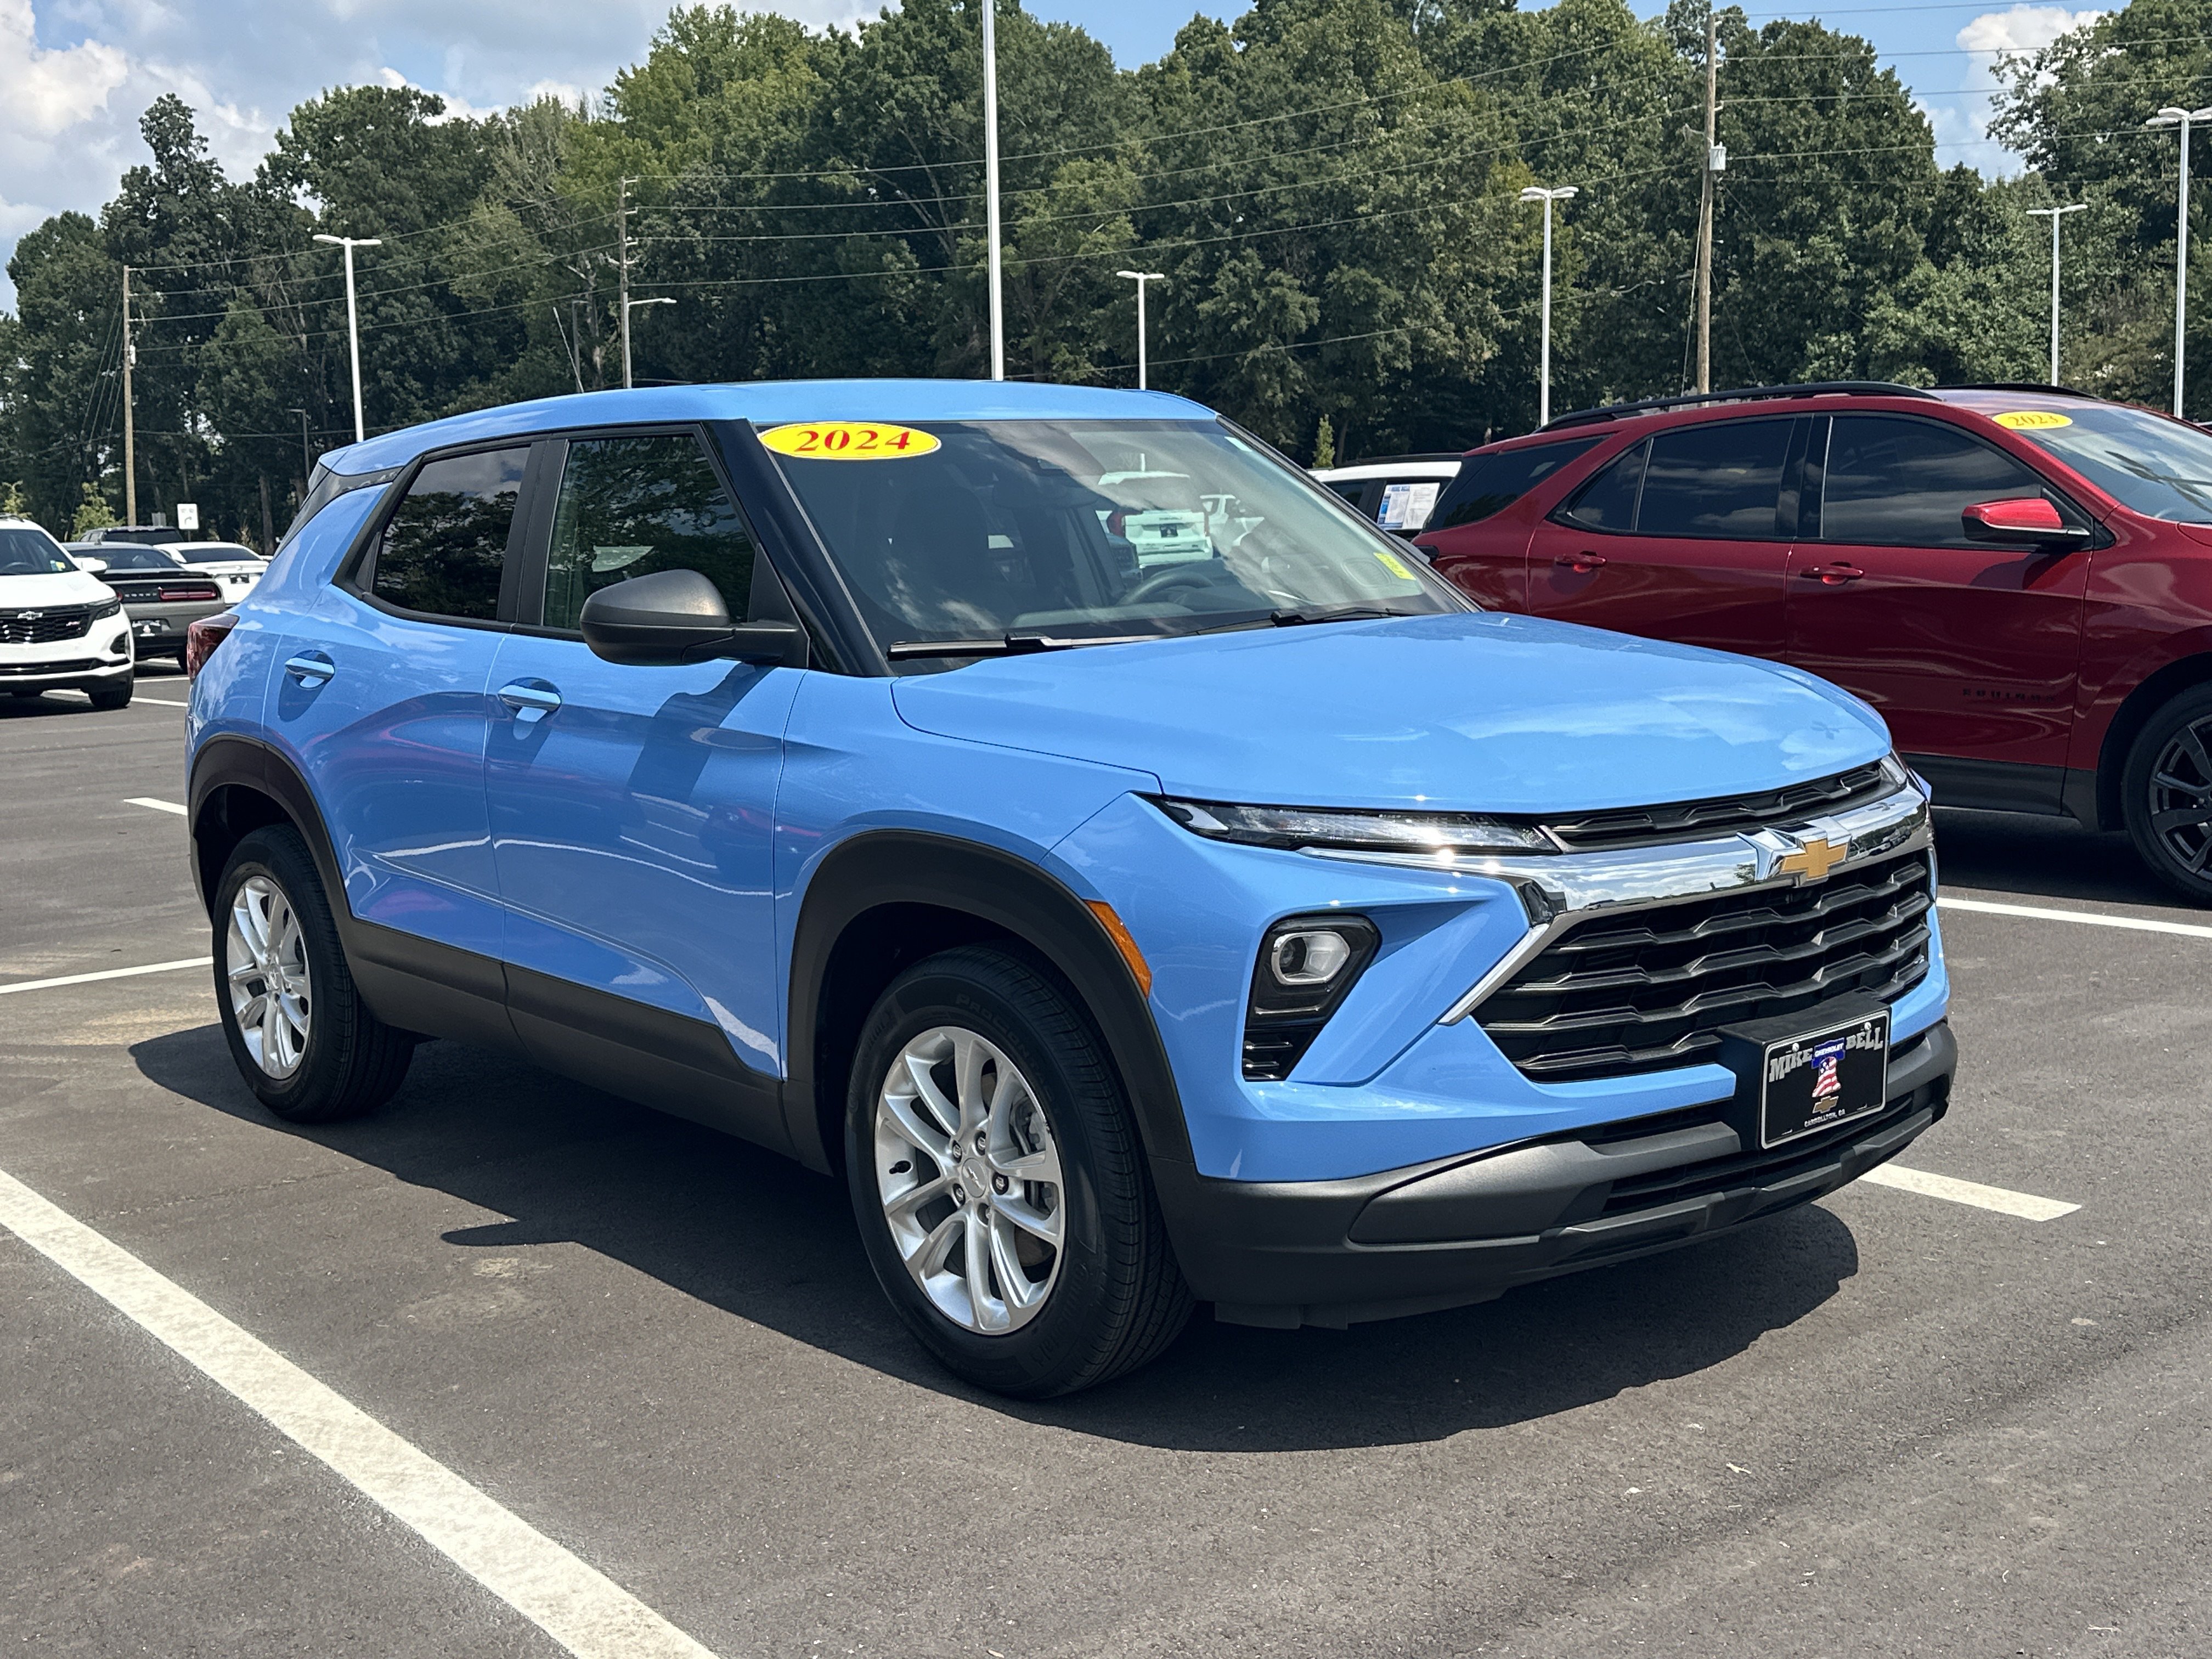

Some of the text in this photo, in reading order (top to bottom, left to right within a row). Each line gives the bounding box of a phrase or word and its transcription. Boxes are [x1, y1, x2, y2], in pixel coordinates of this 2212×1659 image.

[794, 430, 910, 452] 2024
[1768, 1026, 1883, 1082] MIKE BELL
